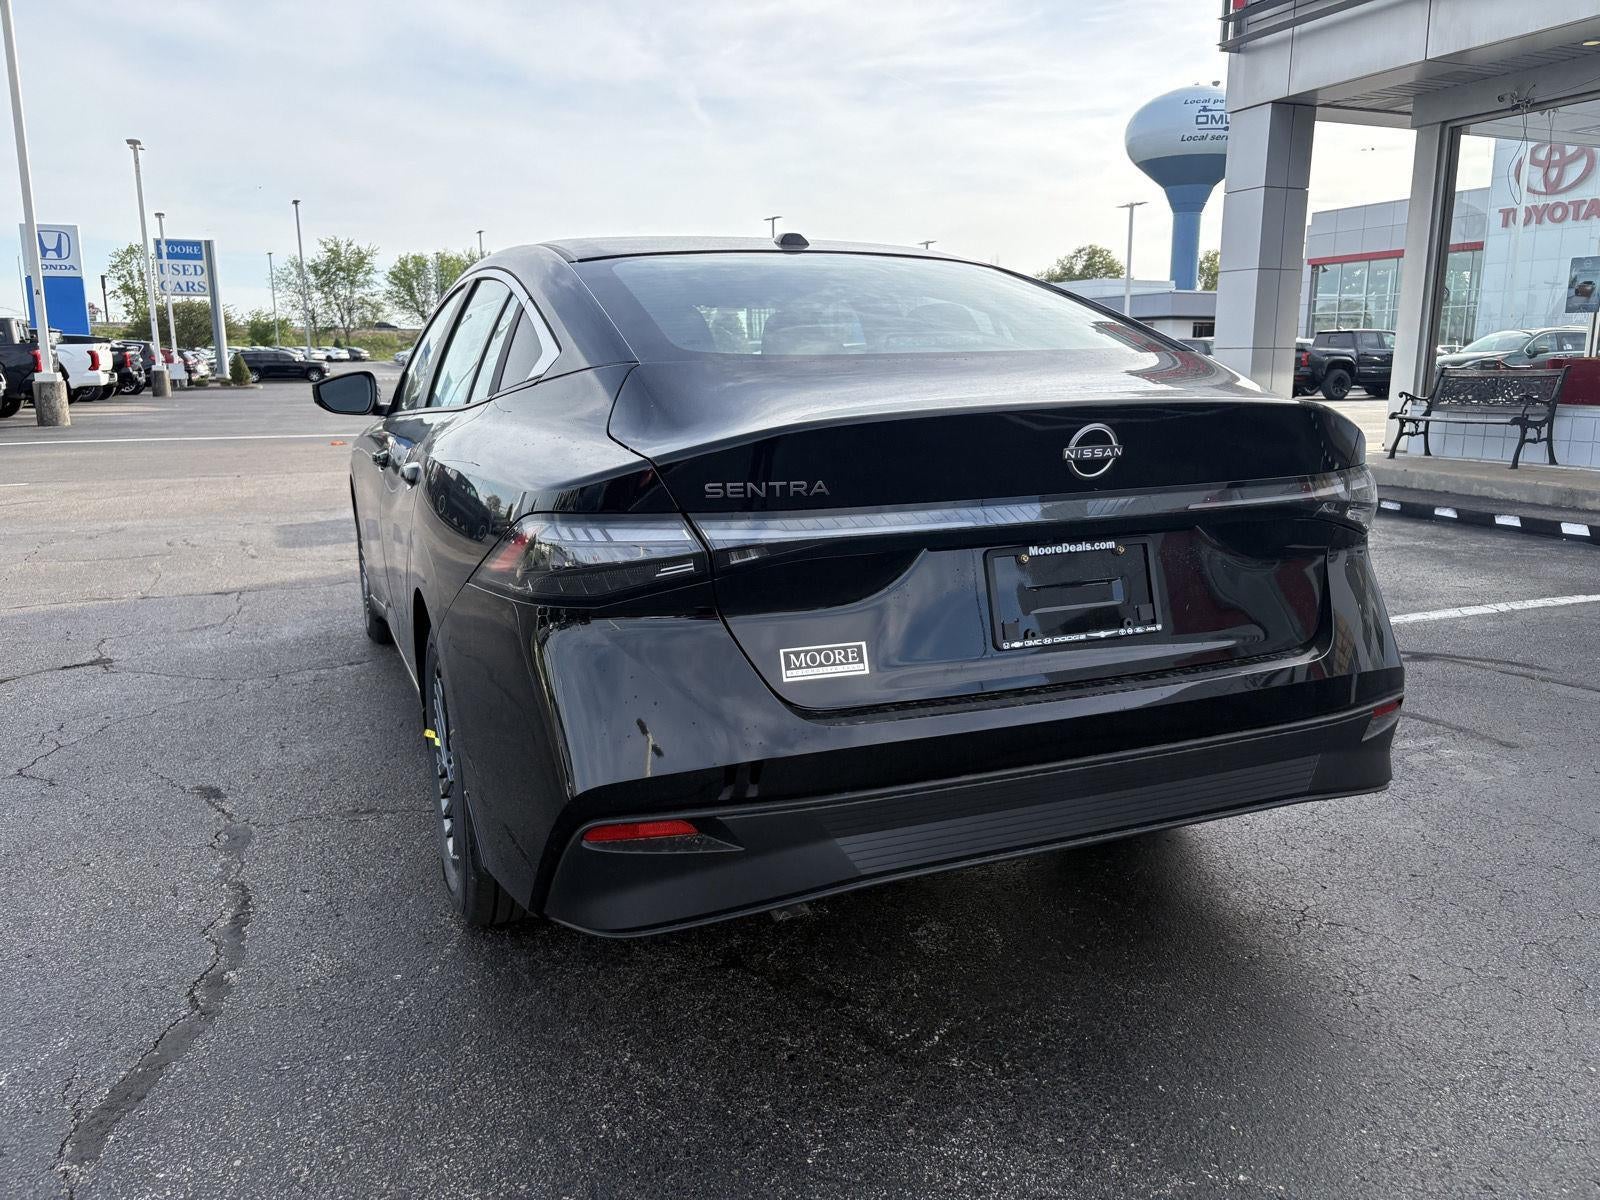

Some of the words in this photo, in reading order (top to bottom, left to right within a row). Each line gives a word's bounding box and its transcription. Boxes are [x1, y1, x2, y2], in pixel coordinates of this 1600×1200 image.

[1181, 133, 1209, 142] Local
[159, 244, 201, 255] OORE
[159, 263, 205, 276] USED
[160, 280, 206, 293] CARS
[1064, 447, 1123, 459] NISSAN
[704, 480, 831, 499] SENTRA
[1028, 541, 1115, 556] MooreDeals.com
[789, 648, 859, 668] MOORE
